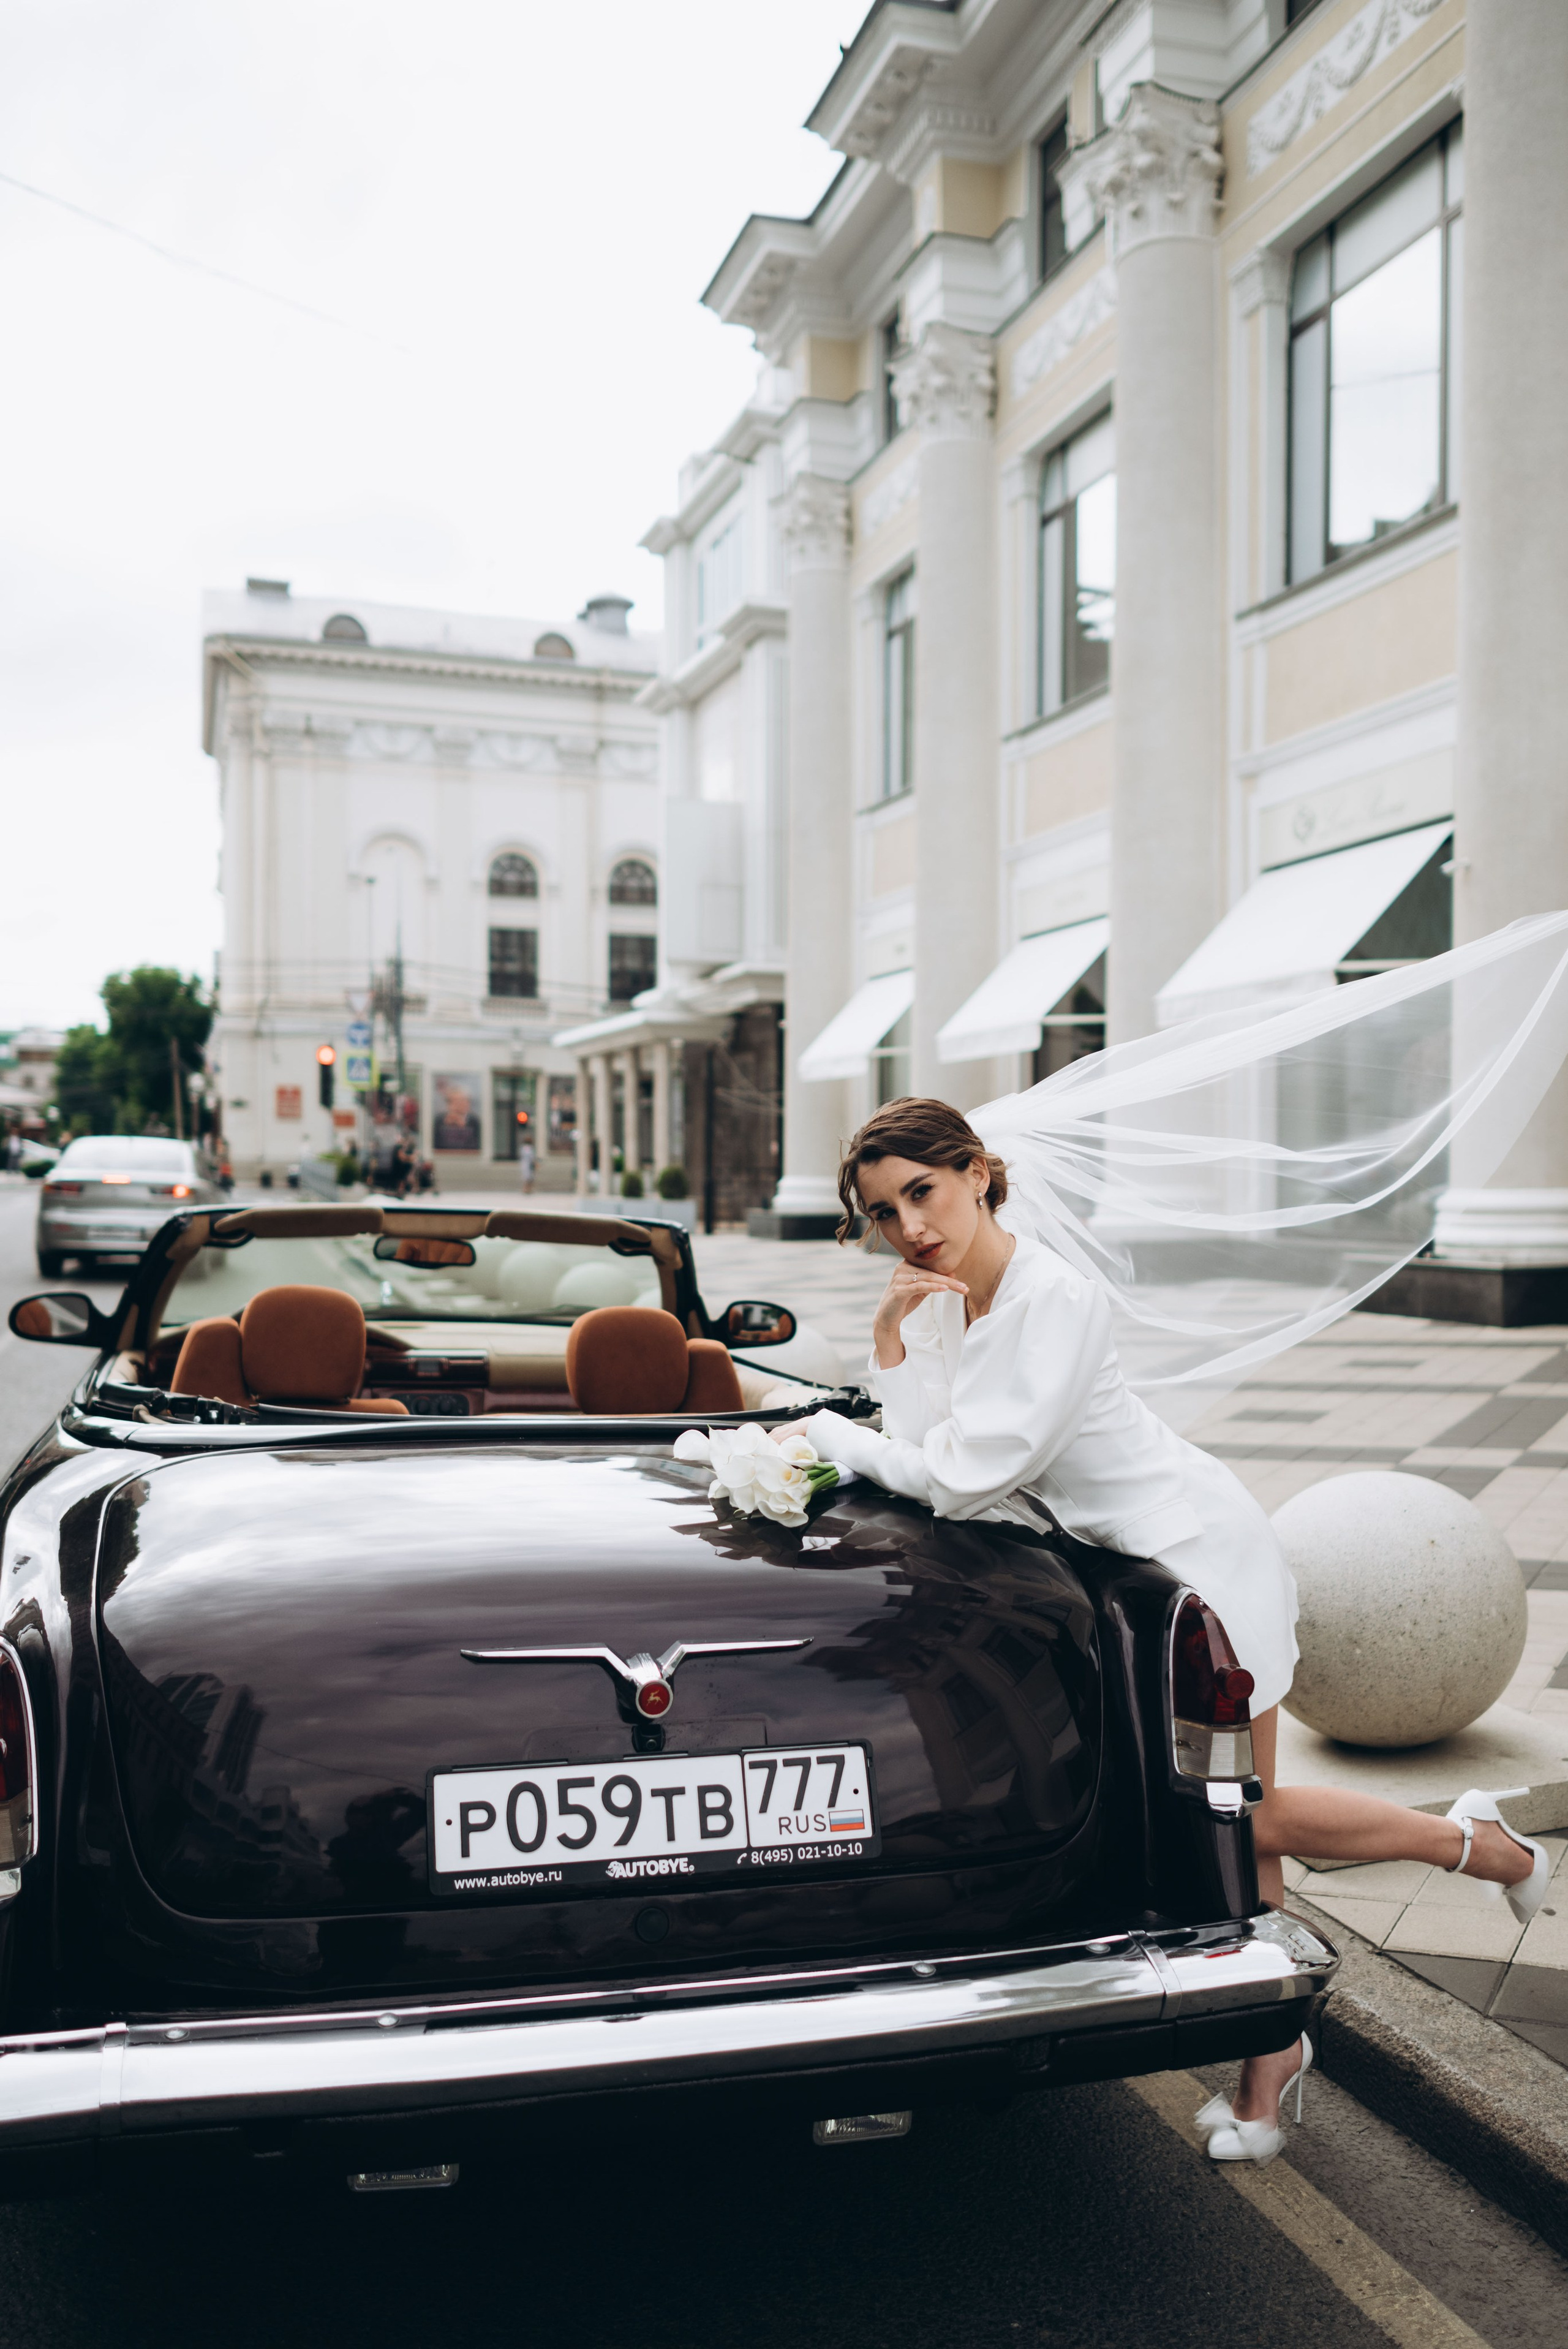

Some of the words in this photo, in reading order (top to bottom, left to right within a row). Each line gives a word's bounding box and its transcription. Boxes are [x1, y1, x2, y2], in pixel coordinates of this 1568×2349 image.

[460, 1774, 734, 1858] P059TB
[748, 1754, 845, 1814] 777
[778, 1814, 826, 1835] RUS
[751, 1848, 793, 1865] 8(495)
[797, 1842, 862, 1859] 021-10-10
[454, 1870, 562, 1889] www.autobye.ru
